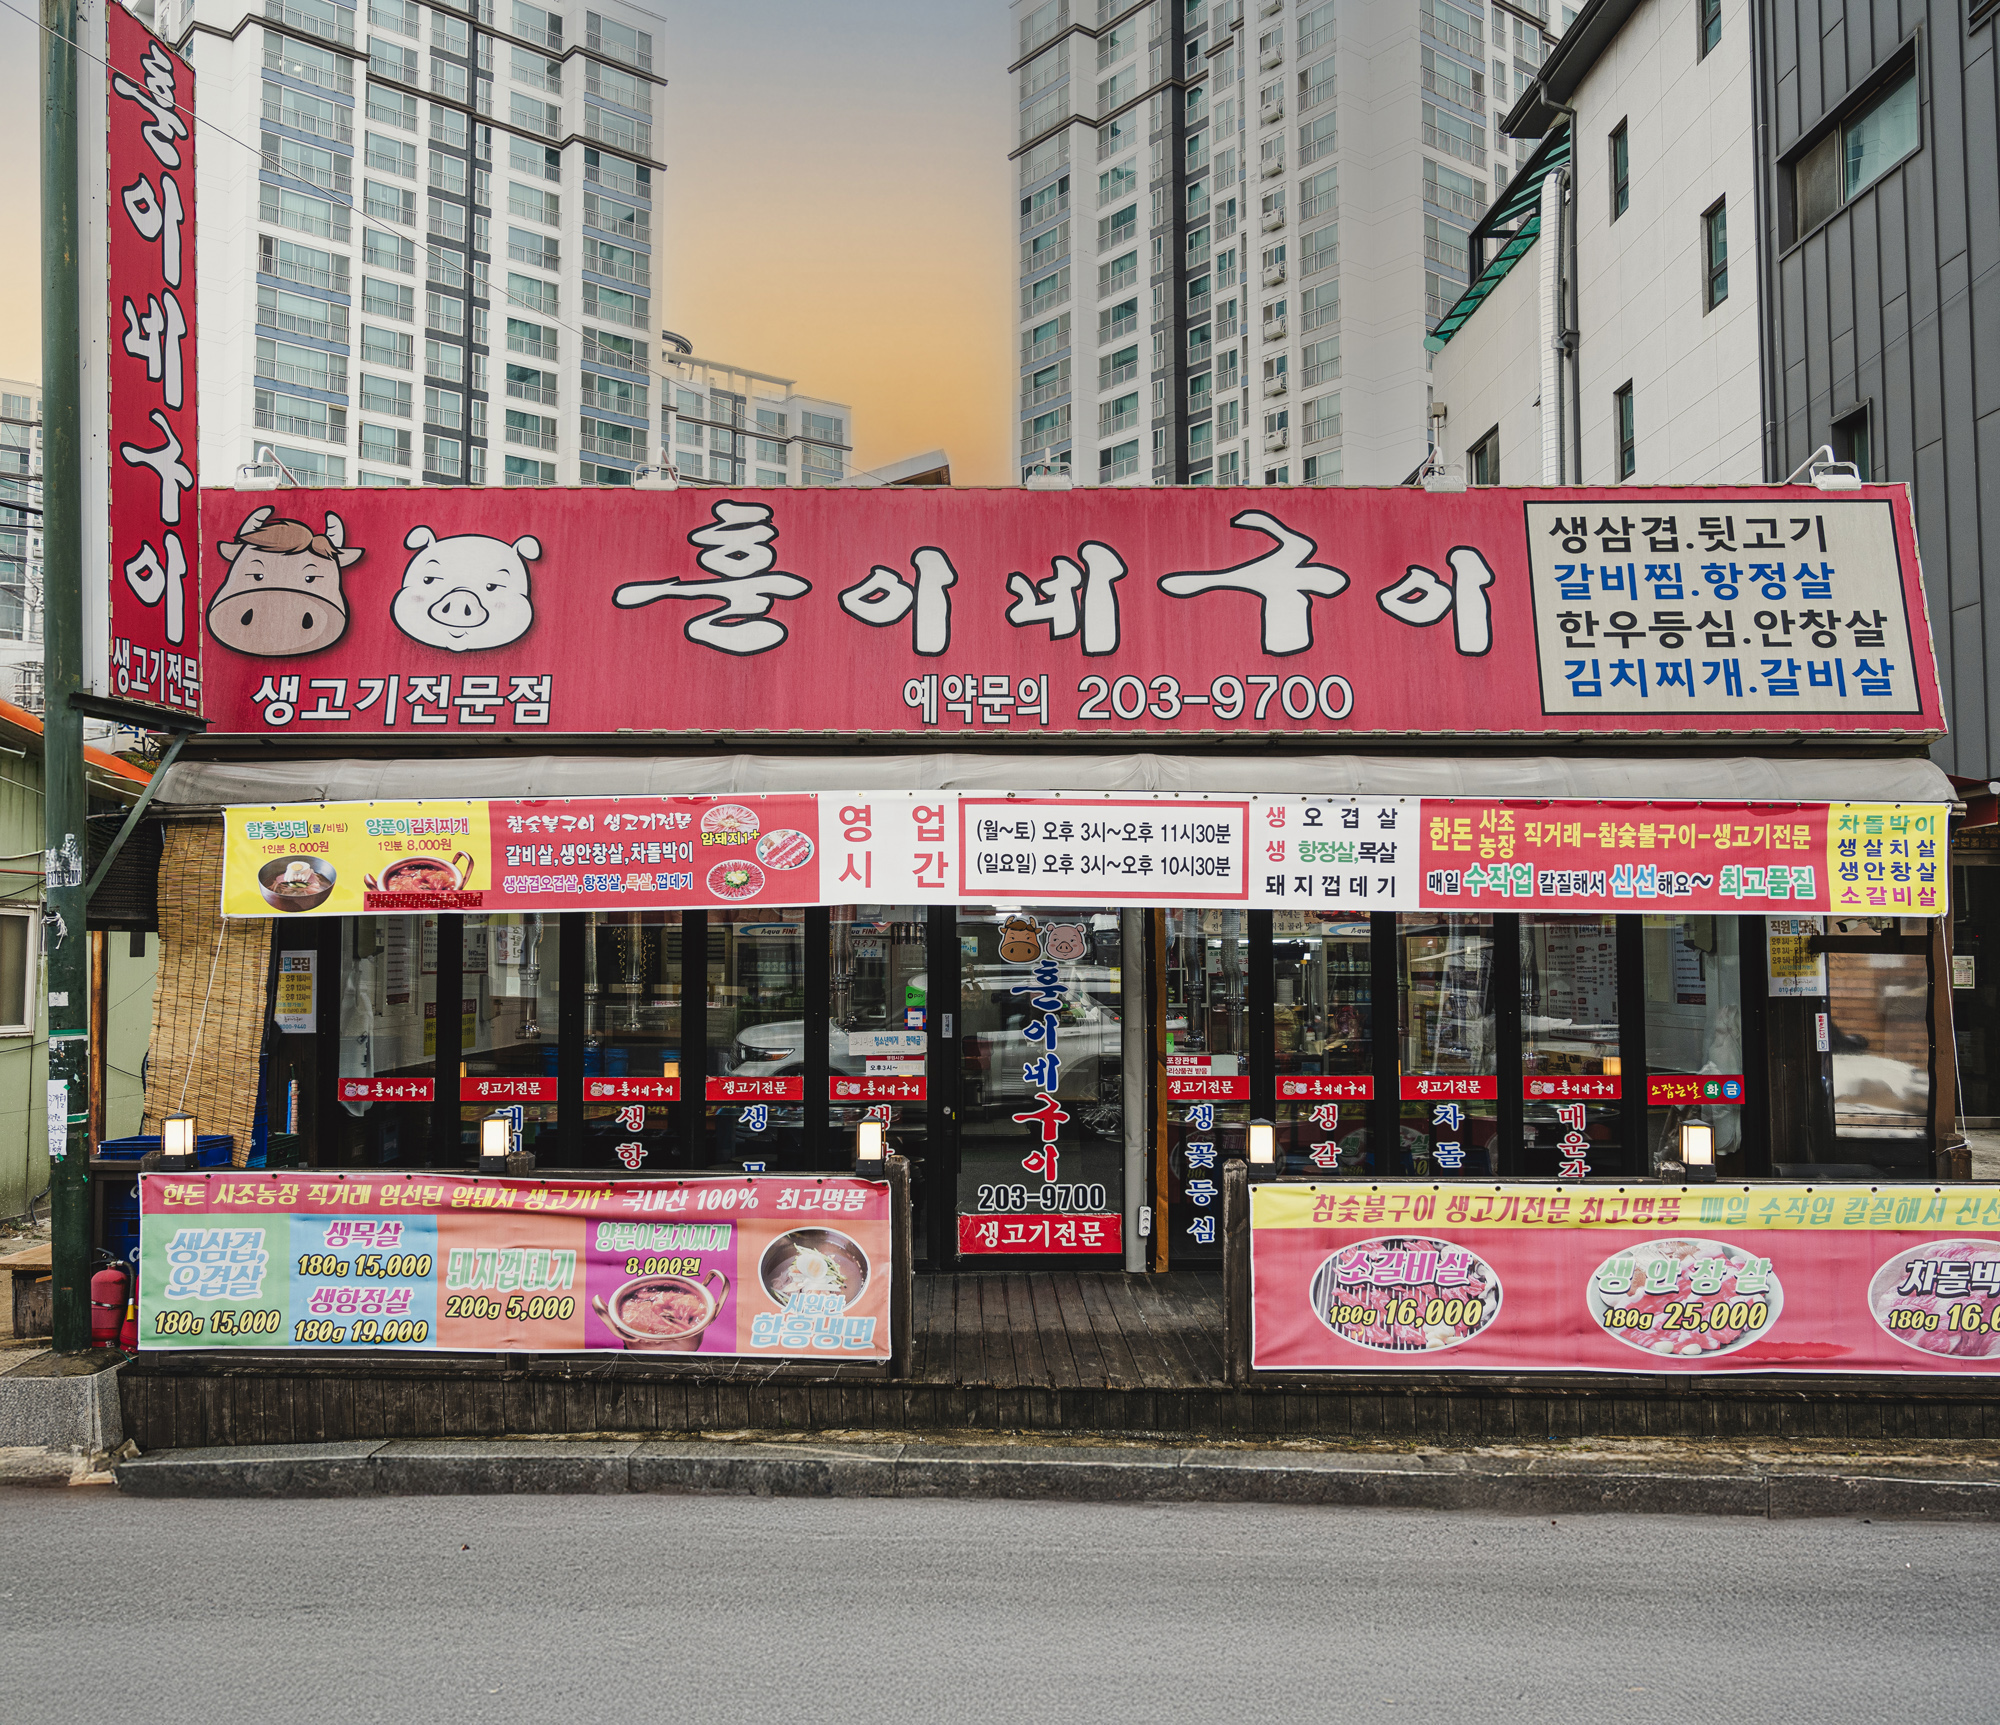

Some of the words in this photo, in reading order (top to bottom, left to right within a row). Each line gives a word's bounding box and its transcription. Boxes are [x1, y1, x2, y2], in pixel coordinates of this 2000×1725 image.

[1549, 515, 1828, 554] 생삼겹.뒷고기
[1554, 563, 1835, 601] 갈비찜.항정살
[1556, 609, 1888, 649] 한우등심.안창살
[112, 637, 200, 708] 생고기전문
[1563, 658, 1895, 698] 김치찌개.갈비살
[252, 674, 553, 726] 생고기전문점
[903, 674, 1048, 725] 예약문의
[1077, 674, 1355, 720] 203-9700
[366, 817, 470, 836] 양푼이김치찌개
[506, 814, 595, 833] 참숯불구이
[603, 812, 692, 832] 생고기전문
[976, 819, 1036, 842] (월~토)
[1042, 821, 1074, 843] 오후
[1080, 821, 1154, 843] 3시~오후
[1160, 822, 1231, 845] 11시30분
[1429, 816, 1473, 851] 한돈
[1478, 808, 1515, 832] 사조
[261, 843, 285, 854] 1인분
[289, 840, 329, 853] 8,000원
[378, 841, 402, 851] 1인분
[406, 838, 452, 851] 8,000원
[1478, 834, 1515, 859] 농장
[976, 852, 1037, 875] (일요일)
[1042, 854, 1074, 875] 오후
[1080, 855, 1154, 876] 3시~오후
[1160, 855, 1231, 877] 10시30분
[1428, 871, 1460, 893] 매일
[1464, 864, 1533, 896] 수작업
[1539, 872, 1606, 895] 칼질해서
[1721, 866, 1816, 899] 최고품질
[292, 958, 310, 971] 모집
[476, 1081, 542, 1096] 생고기전문
[722, 1080, 787, 1095] 생고기전문
[1168, 1080, 1234, 1095] 생고기전문
[1416, 1080, 1481, 1095] 생고기전문
[162, 1183, 206, 1206] 한돈
[212, 1183, 300, 1206] 사조농장
[307, 1183, 371, 1206] 직거래
[380, 1184, 445, 1207] 엄선된
[451, 1186, 519, 1209] 암돼지
[622, 1188, 692, 1212] 국내산
[697, 1187, 759, 1211] 100%
[776, 1188, 867, 1211] 최고명품
[978, 1184, 1106, 1211] 203-9700
[1312, 1194, 1437, 1223] 참숯불구이
[1445, 1194, 1571, 1224] 생고기전문
[1579, 1196, 1682, 1225] 최고명품
[1699, 1196, 1750, 1225] 매일
[1758, 1196, 1835, 1226] 수작업
[1843, 1196, 1945, 1226] 칼질해서
[323, 1220, 403, 1248] 생목살
[595, 1222, 733, 1253] 양푼이김치찌개
[975, 1220, 1105, 1248] 생고기전문
[297, 1254, 349, 1279] 180g
[355, 1254, 432, 1279] 15,000
[446, 1249, 577, 1291] 돼지껍데기
[625, 1256, 701, 1277] 8,000원
[1338, 1250, 1474, 1286] 소갈비살
[1598, 1258, 1772, 1294] 생안창살
[166, 1264, 264, 1300] 오겹살
[307, 1286, 415, 1315] 생항정살
[445, 1295, 502, 1321] 200g
[505, 1295, 575, 1321] 5,000
[1329, 1305, 1377, 1327] 180g
[1384, 1298, 1484, 1328] 16,000
[155, 1311, 205, 1336] 180g
[210, 1309, 282, 1335] 15,000
[1603, 1307, 1654, 1332] 180g
[1661, 1301, 1769, 1333] 25,000
[1888, 1308, 1941, 1332] 180g
[294, 1319, 346, 1344] 180g
[351, 1319, 429, 1345] 19,000
[751, 1314, 877, 1349] 함흥냉면
